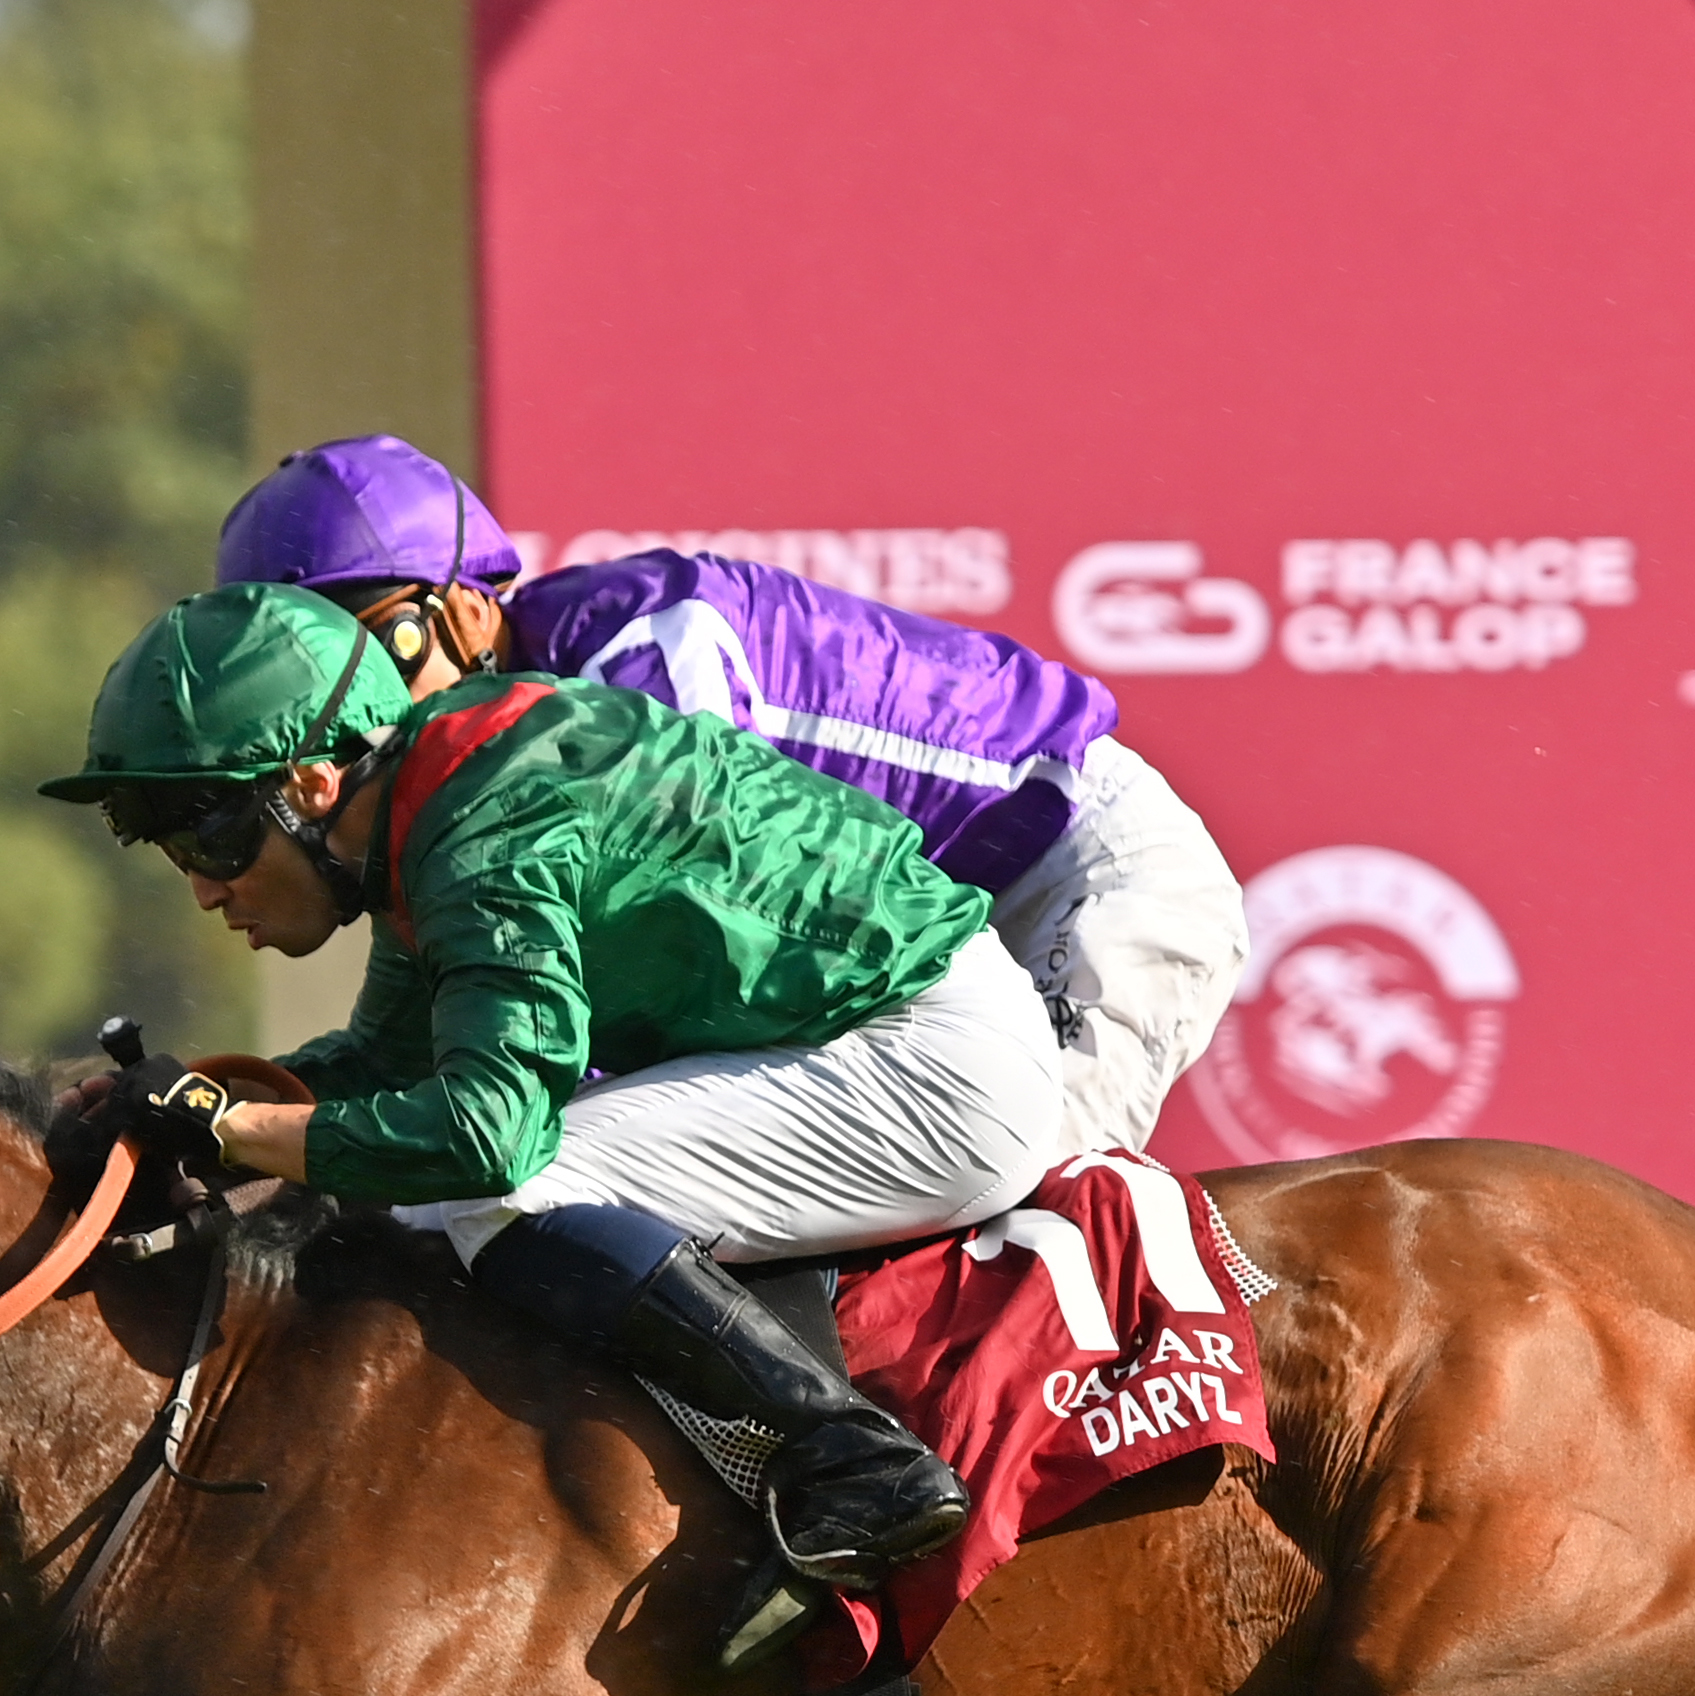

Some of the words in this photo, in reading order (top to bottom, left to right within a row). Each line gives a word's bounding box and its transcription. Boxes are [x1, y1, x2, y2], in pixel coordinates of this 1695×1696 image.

[1281, 537, 1636, 606] FRANCE
[1281, 602, 1587, 673] GALOP
[1080, 1371, 1244, 1458] DARYZ
